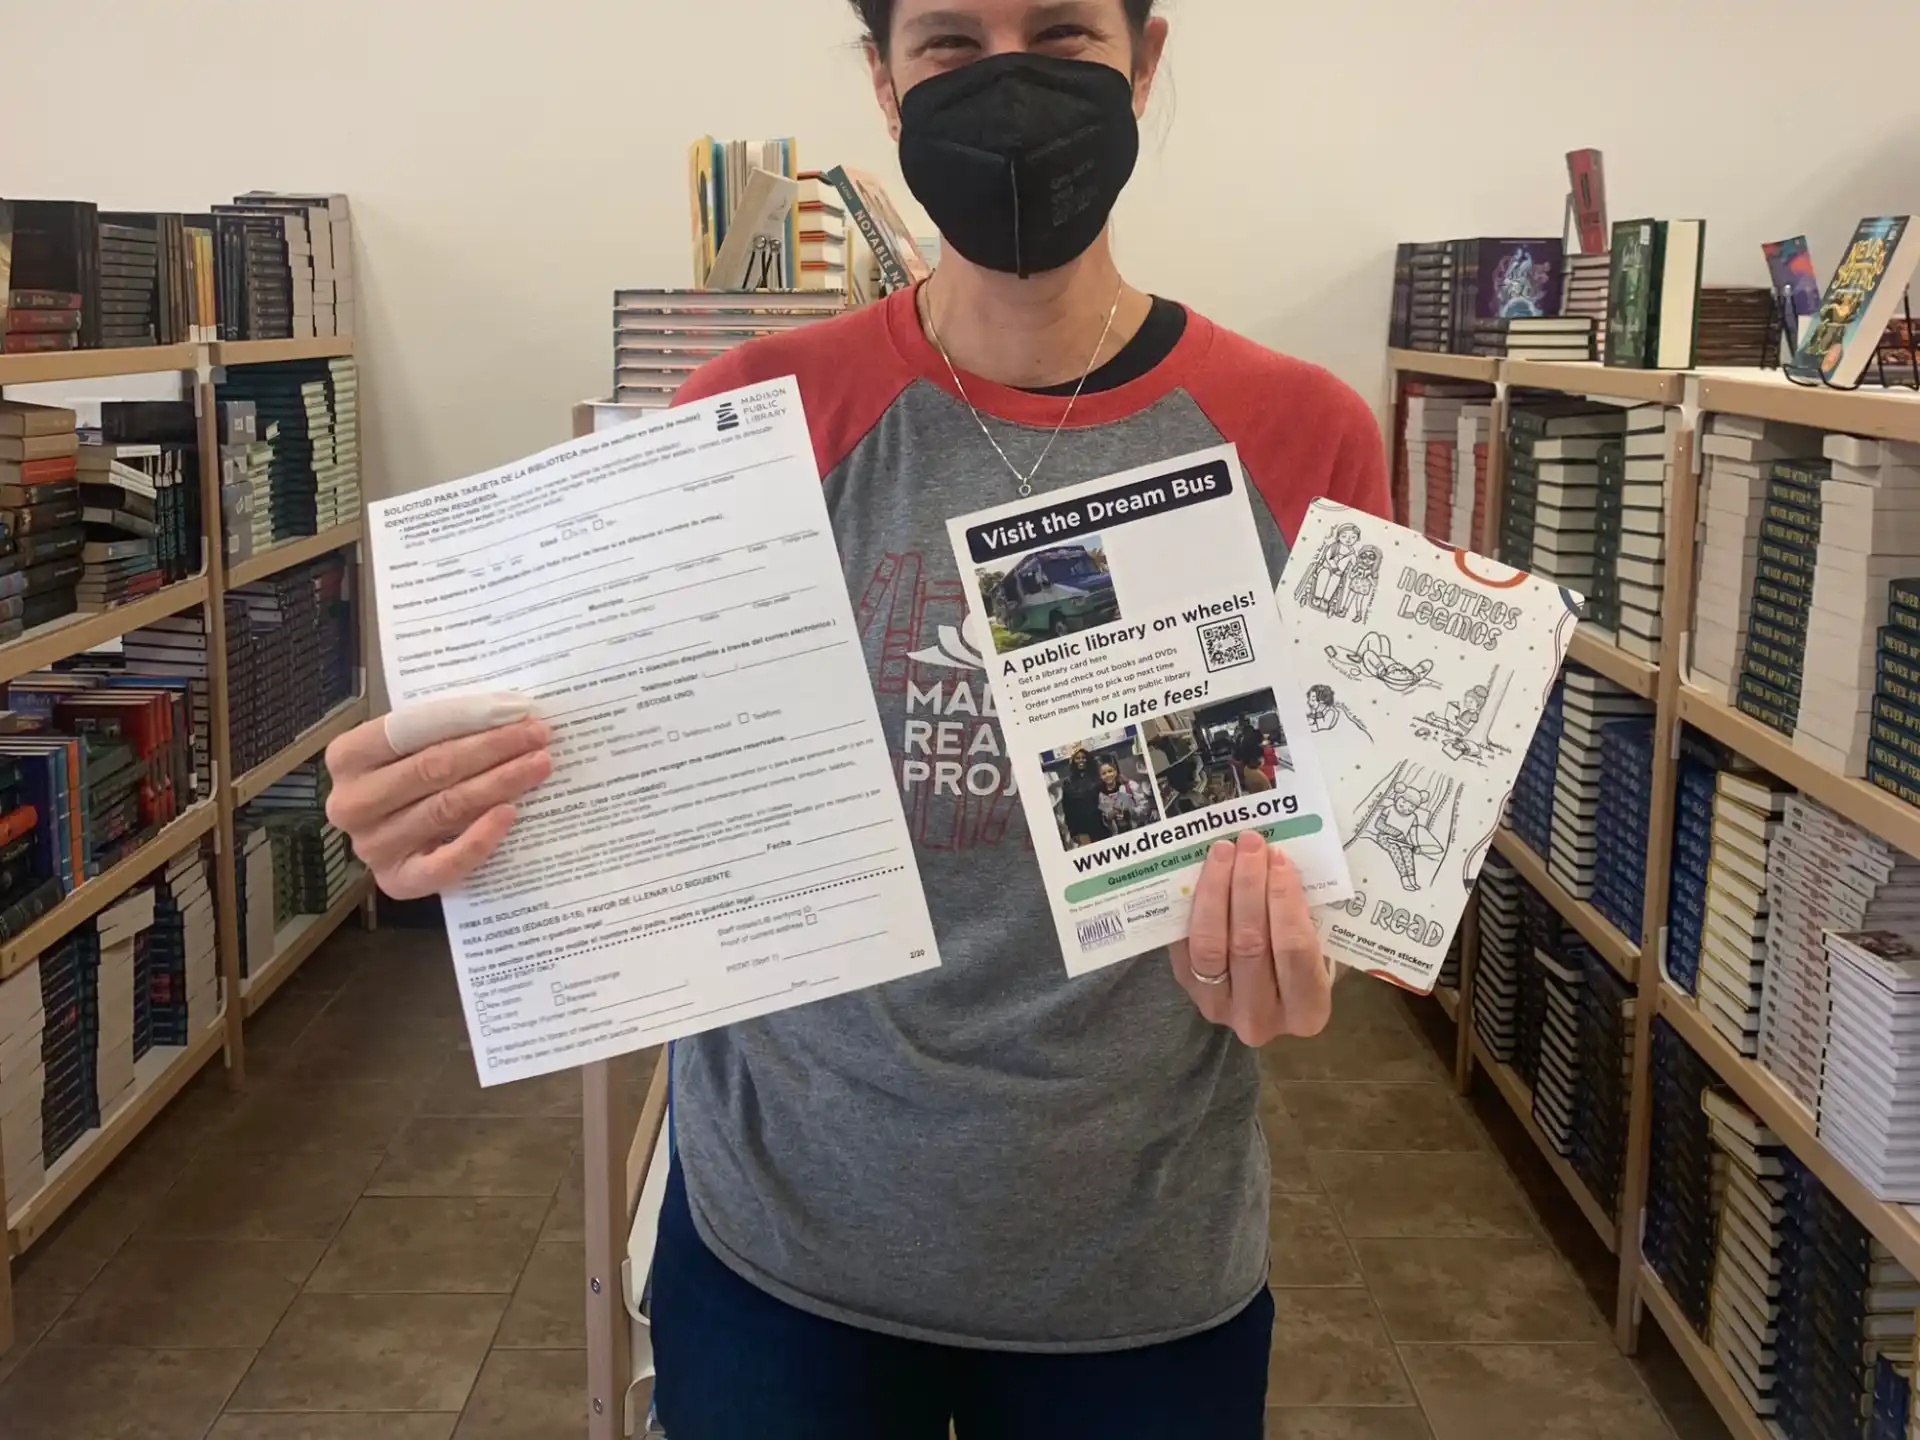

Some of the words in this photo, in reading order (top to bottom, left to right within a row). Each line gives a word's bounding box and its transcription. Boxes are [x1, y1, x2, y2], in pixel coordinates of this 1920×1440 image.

[741, 388, 786, 404] MADISON
[743, 400, 777, 414] PUBLIC
[746, 408, 786, 424] LIBRARY
[981, 521, 1037, 549] Visit
[1041, 512, 1080, 534] the
[1087, 488, 1166, 521] Dream
[1171, 475, 1216, 498] Bus
[1397, 566, 1522, 630] NOSOTROS
[1003, 660, 1017, 676] A
[1022, 642, 1080, 673] public
[1085, 624, 1145, 651] library
[1153, 616, 1177, 631] on
[1182, 591, 1255, 623] wheels!
[1018, 676, 1033, 685] Get
[1041, 666, 1067, 678] library
[1070, 659, 1088, 670] card
[1089, 655, 1107, 664] here
[1021, 685, 1051, 698] Browse
[1054, 678, 1069, 688] and
[1070, 672, 1094, 683] check
[1096, 667, 1110, 676] out
[1111, 660, 1136, 671] books
[1138, 654, 1153, 663] and
[1154, 648, 1177, 659] DVDs
[1025, 699, 1048, 710] Order
[1051, 686, 1093, 703] something
[1105, 677, 1122, 688] pick
[1136, 667, 1154, 677] next
[1156, 662, 1174, 672] time
[1028, 711, 1056, 723] Return
[1058, 704, 1079, 714] items
[1081, 697, 1099, 707] here
[1122, 687, 1136, 695] any
[1138, 678, 1163, 691] public
[1164, 671, 1190, 682] library
[1092, 710, 1117, 728] No
[1124, 699, 1157, 718] late
[1164, 680, 1208, 706] fees!
[904, 720, 1012, 757] REA
[1069, 795, 1298, 872] www.dreambus.org
[1108, 862, 1158, 885] Questions?
[1161, 856, 1179, 868] Call
[1181, 853, 1192, 861] us
[1195, 848, 1203, 857] at
[910, 949, 924, 958] 2/20
[1332, 924, 1355, 939] Color
[1356, 936, 1376, 947] your
[1378, 945, 1396, 955] own
[1397, 952, 1433, 969] stickers!
